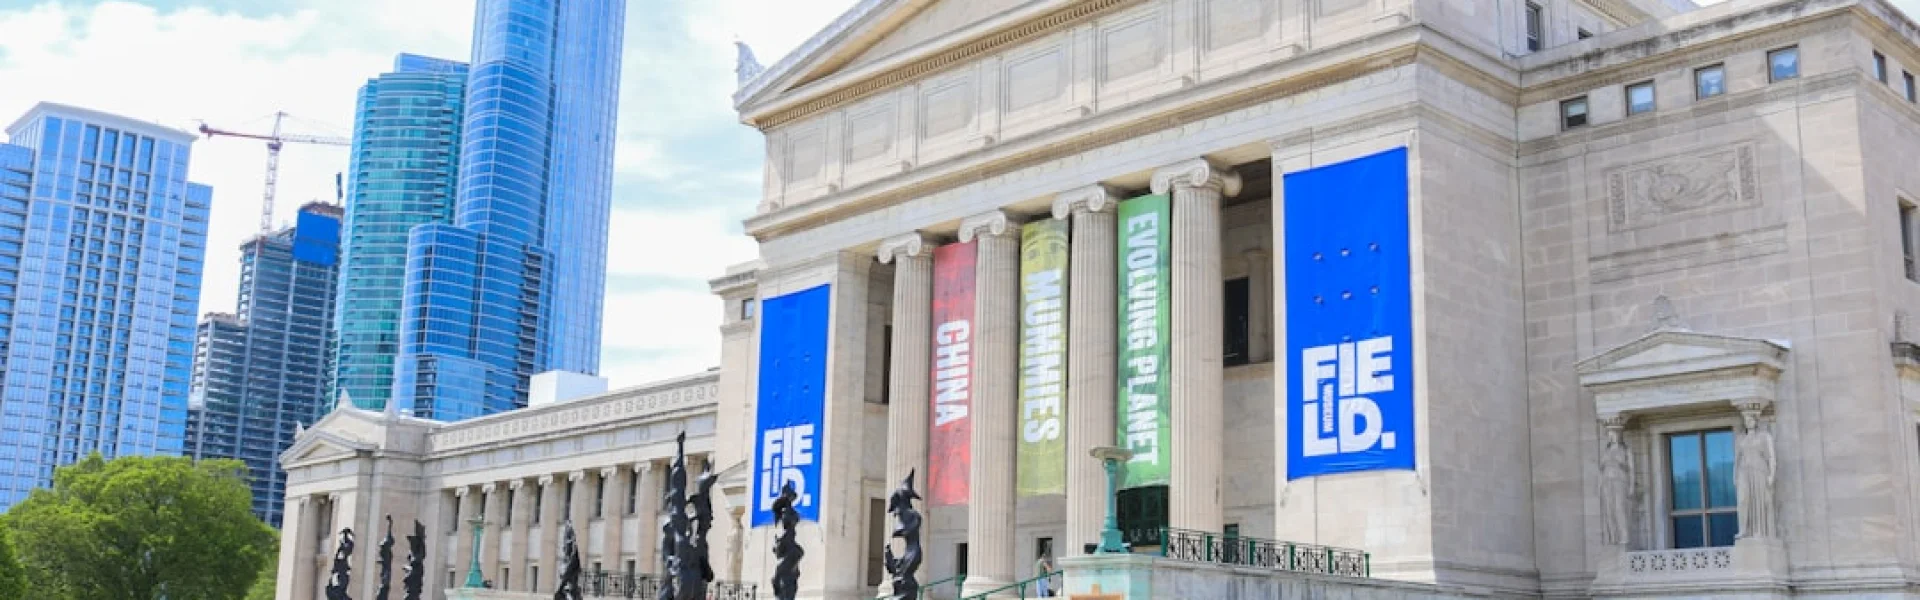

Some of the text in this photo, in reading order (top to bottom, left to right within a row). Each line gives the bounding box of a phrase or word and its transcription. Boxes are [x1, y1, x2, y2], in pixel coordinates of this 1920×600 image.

[936, 320, 969, 426] CHINA
[1024, 269, 1060, 442] MUMMIES
[1127, 212, 1158, 465] EVOLVING PLANET
